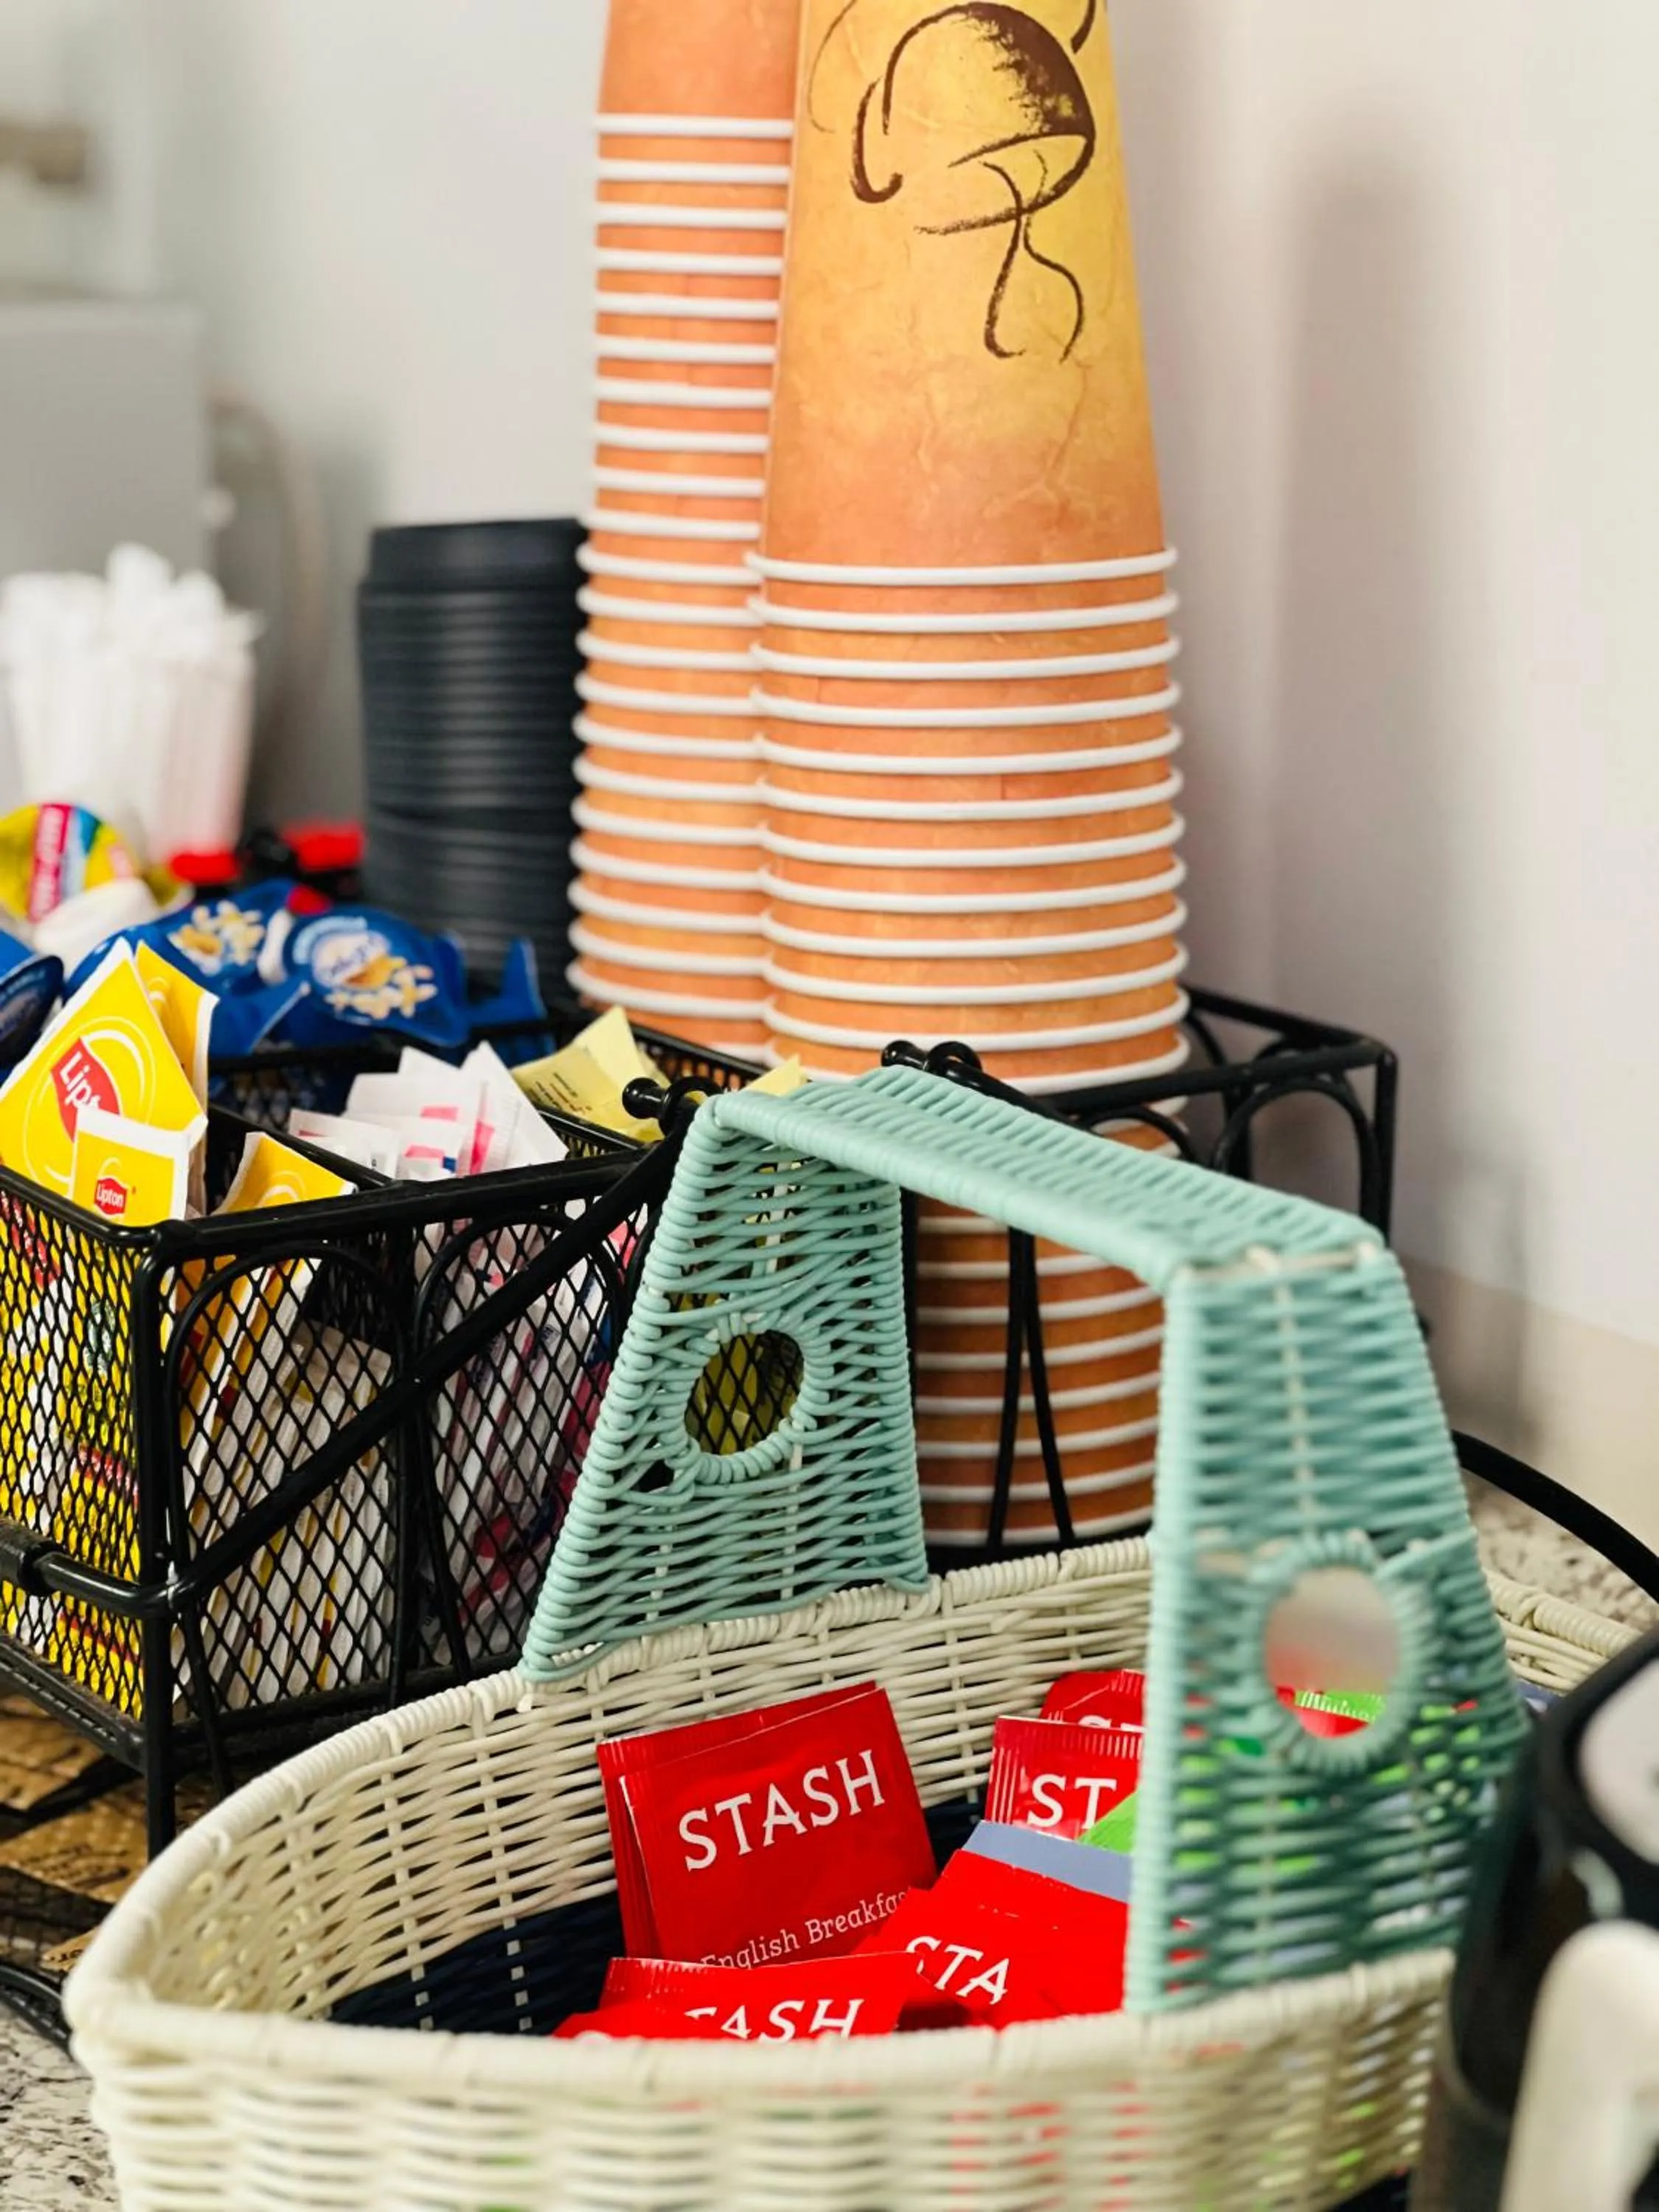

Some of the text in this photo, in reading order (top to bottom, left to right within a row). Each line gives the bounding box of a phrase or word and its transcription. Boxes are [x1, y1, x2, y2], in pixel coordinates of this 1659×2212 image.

[97, 1182, 125, 1208] Lipton
[678, 1749, 885, 1872] STASH
[684, 1999, 865, 2044] ASH
